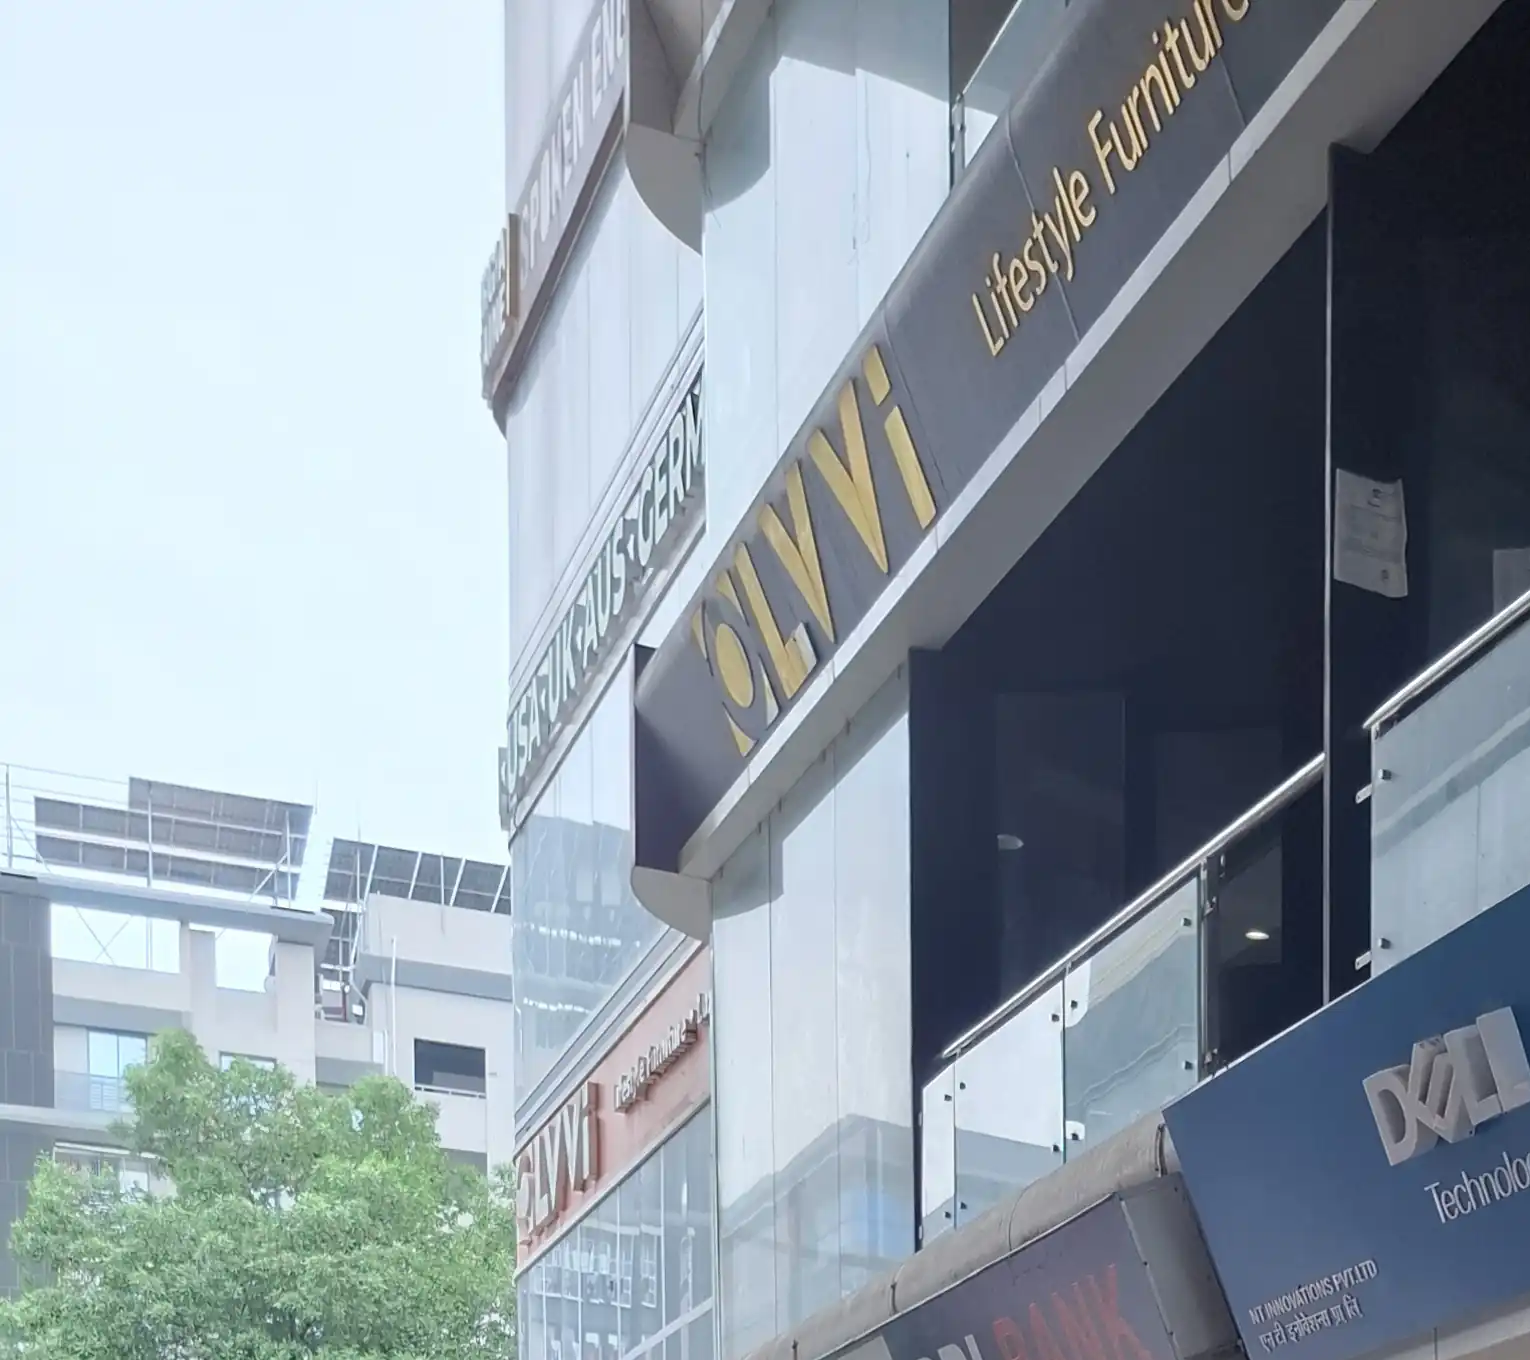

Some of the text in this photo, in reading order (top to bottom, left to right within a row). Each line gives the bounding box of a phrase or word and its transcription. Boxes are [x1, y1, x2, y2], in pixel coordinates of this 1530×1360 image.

[520, 60, 586, 287] SPOKEN
[972, 167, 1096, 356] Lifestyle
[1249, 1306, 1266, 1325] NT
[1265, 1277, 1334, 1321] INNOVATIONS
